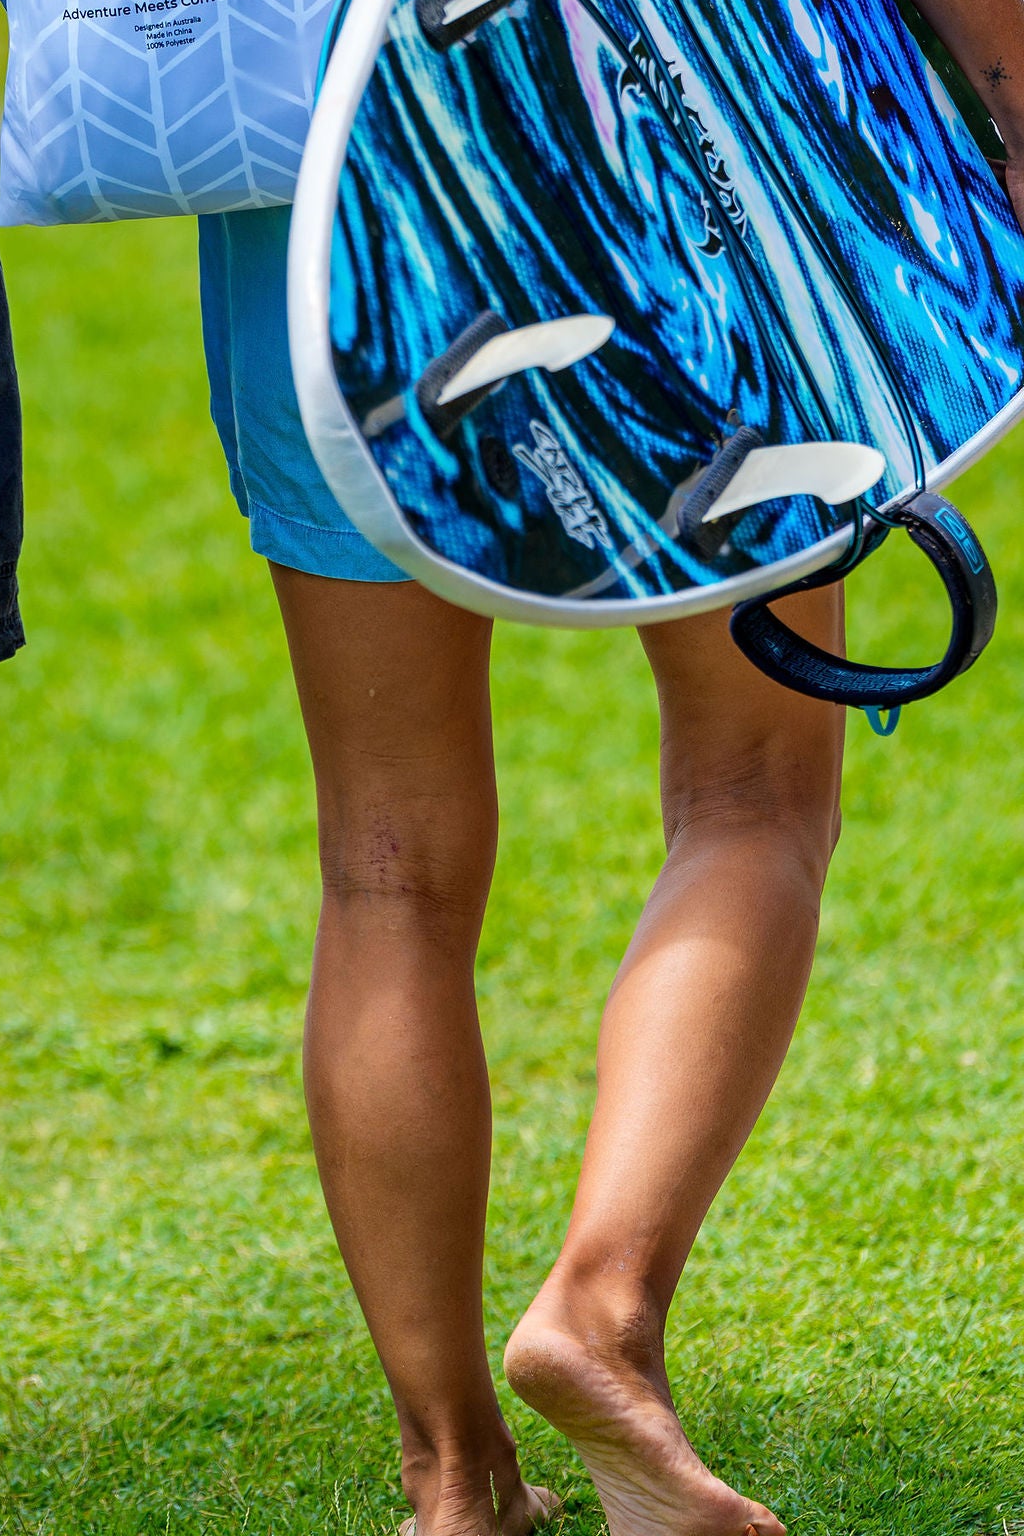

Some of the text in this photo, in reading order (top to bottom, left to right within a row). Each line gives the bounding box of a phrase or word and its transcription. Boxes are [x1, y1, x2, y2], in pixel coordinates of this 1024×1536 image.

[63, 6, 131, 20] Adventure
[134, 0, 178, 14] Meets
[134, 20, 164, 32] Designed
[173, 15, 202, 26] Australia
[146, 31, 165, 40] Made
[173, 27, 193, 36] China
[147, 36, 196, 50] 100% Polyester
